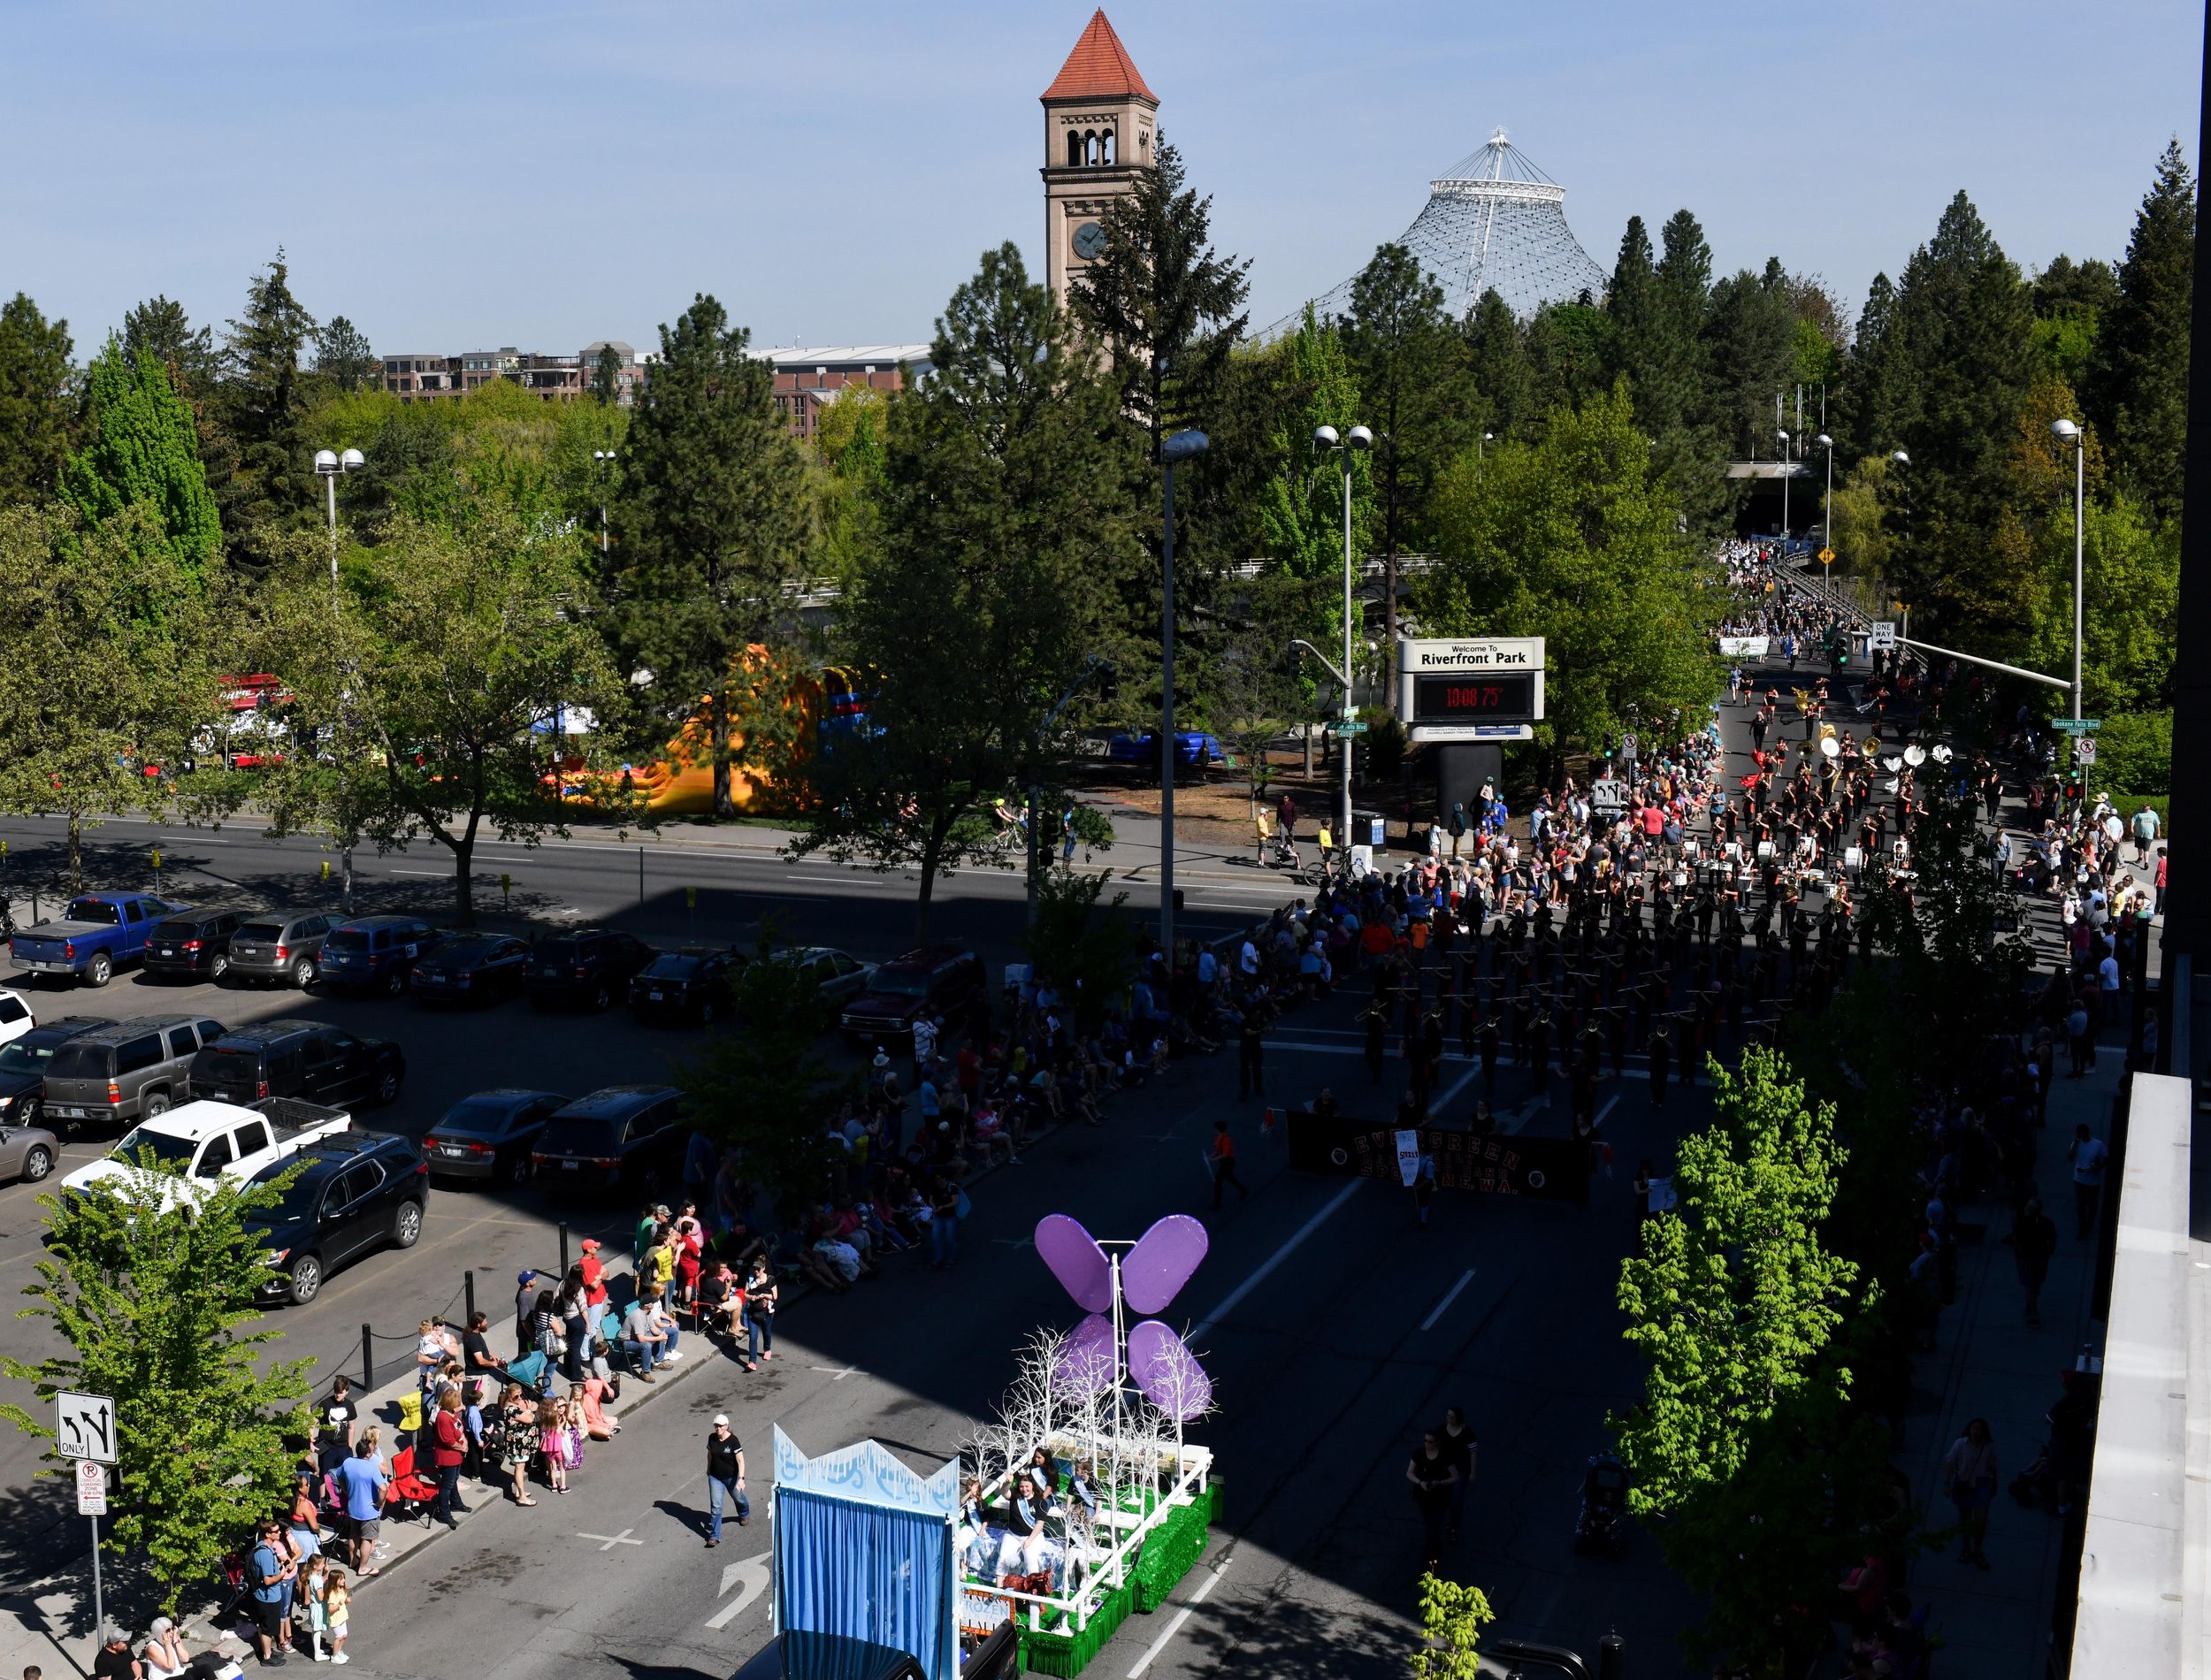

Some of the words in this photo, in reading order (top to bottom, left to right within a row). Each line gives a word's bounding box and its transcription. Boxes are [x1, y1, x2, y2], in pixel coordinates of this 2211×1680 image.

[1421, 653, 1489, 665] Riverfront
[1496, 652, 1526, 663] Park
[1446, 688, 1478, 707] 10:08
[62, 1442, 85, 1455] ONLY
[965, 1600, 1008, 1617] ROZEN
